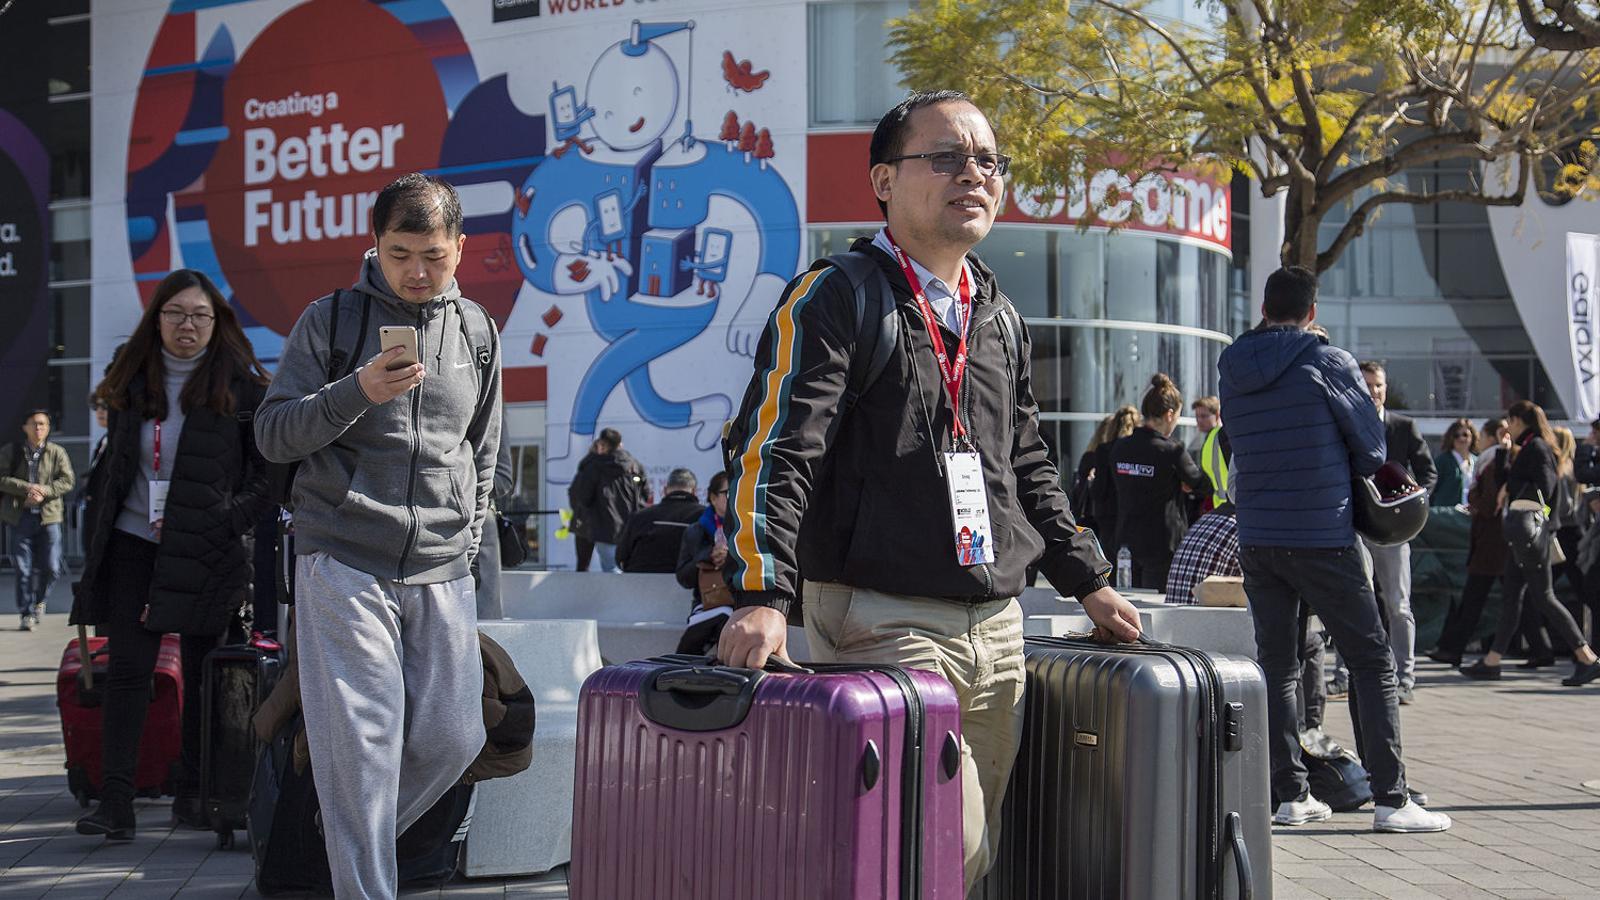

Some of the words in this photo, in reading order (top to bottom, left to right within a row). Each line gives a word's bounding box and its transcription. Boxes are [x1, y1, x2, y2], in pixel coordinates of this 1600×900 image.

[547, 0, 625, 15] WORLD
[244, 91, 324, 120] Creating
[326, 91, 339, 110] a
[244, 123, 404, 185] Better
[244, 189, 378, 246] Futur
[1000, 146, 1228, 241] elcome
